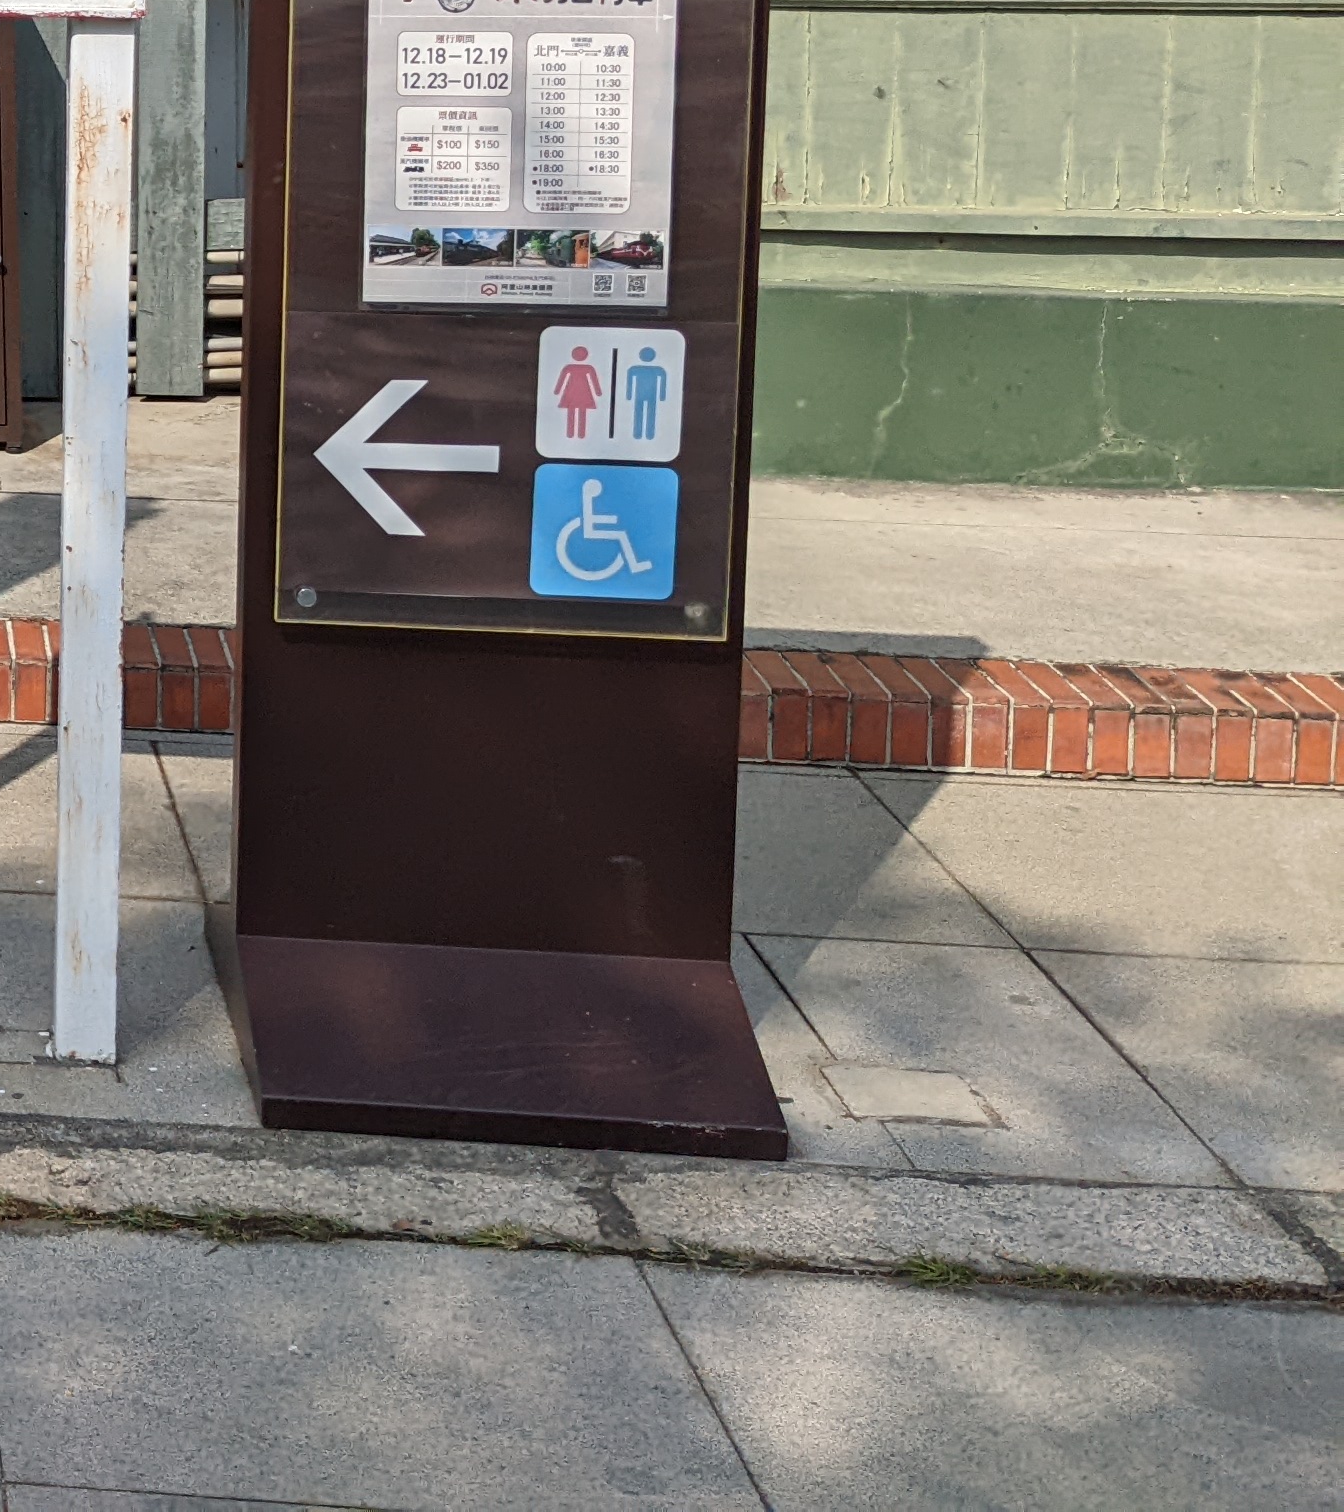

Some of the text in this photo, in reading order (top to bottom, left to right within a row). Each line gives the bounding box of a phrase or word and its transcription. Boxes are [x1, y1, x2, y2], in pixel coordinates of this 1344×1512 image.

[533, 45, 629, 58] 北門 嘉義
[437, 139, 499, 149] $100 $150
[437, 160, 462, 170] $200
